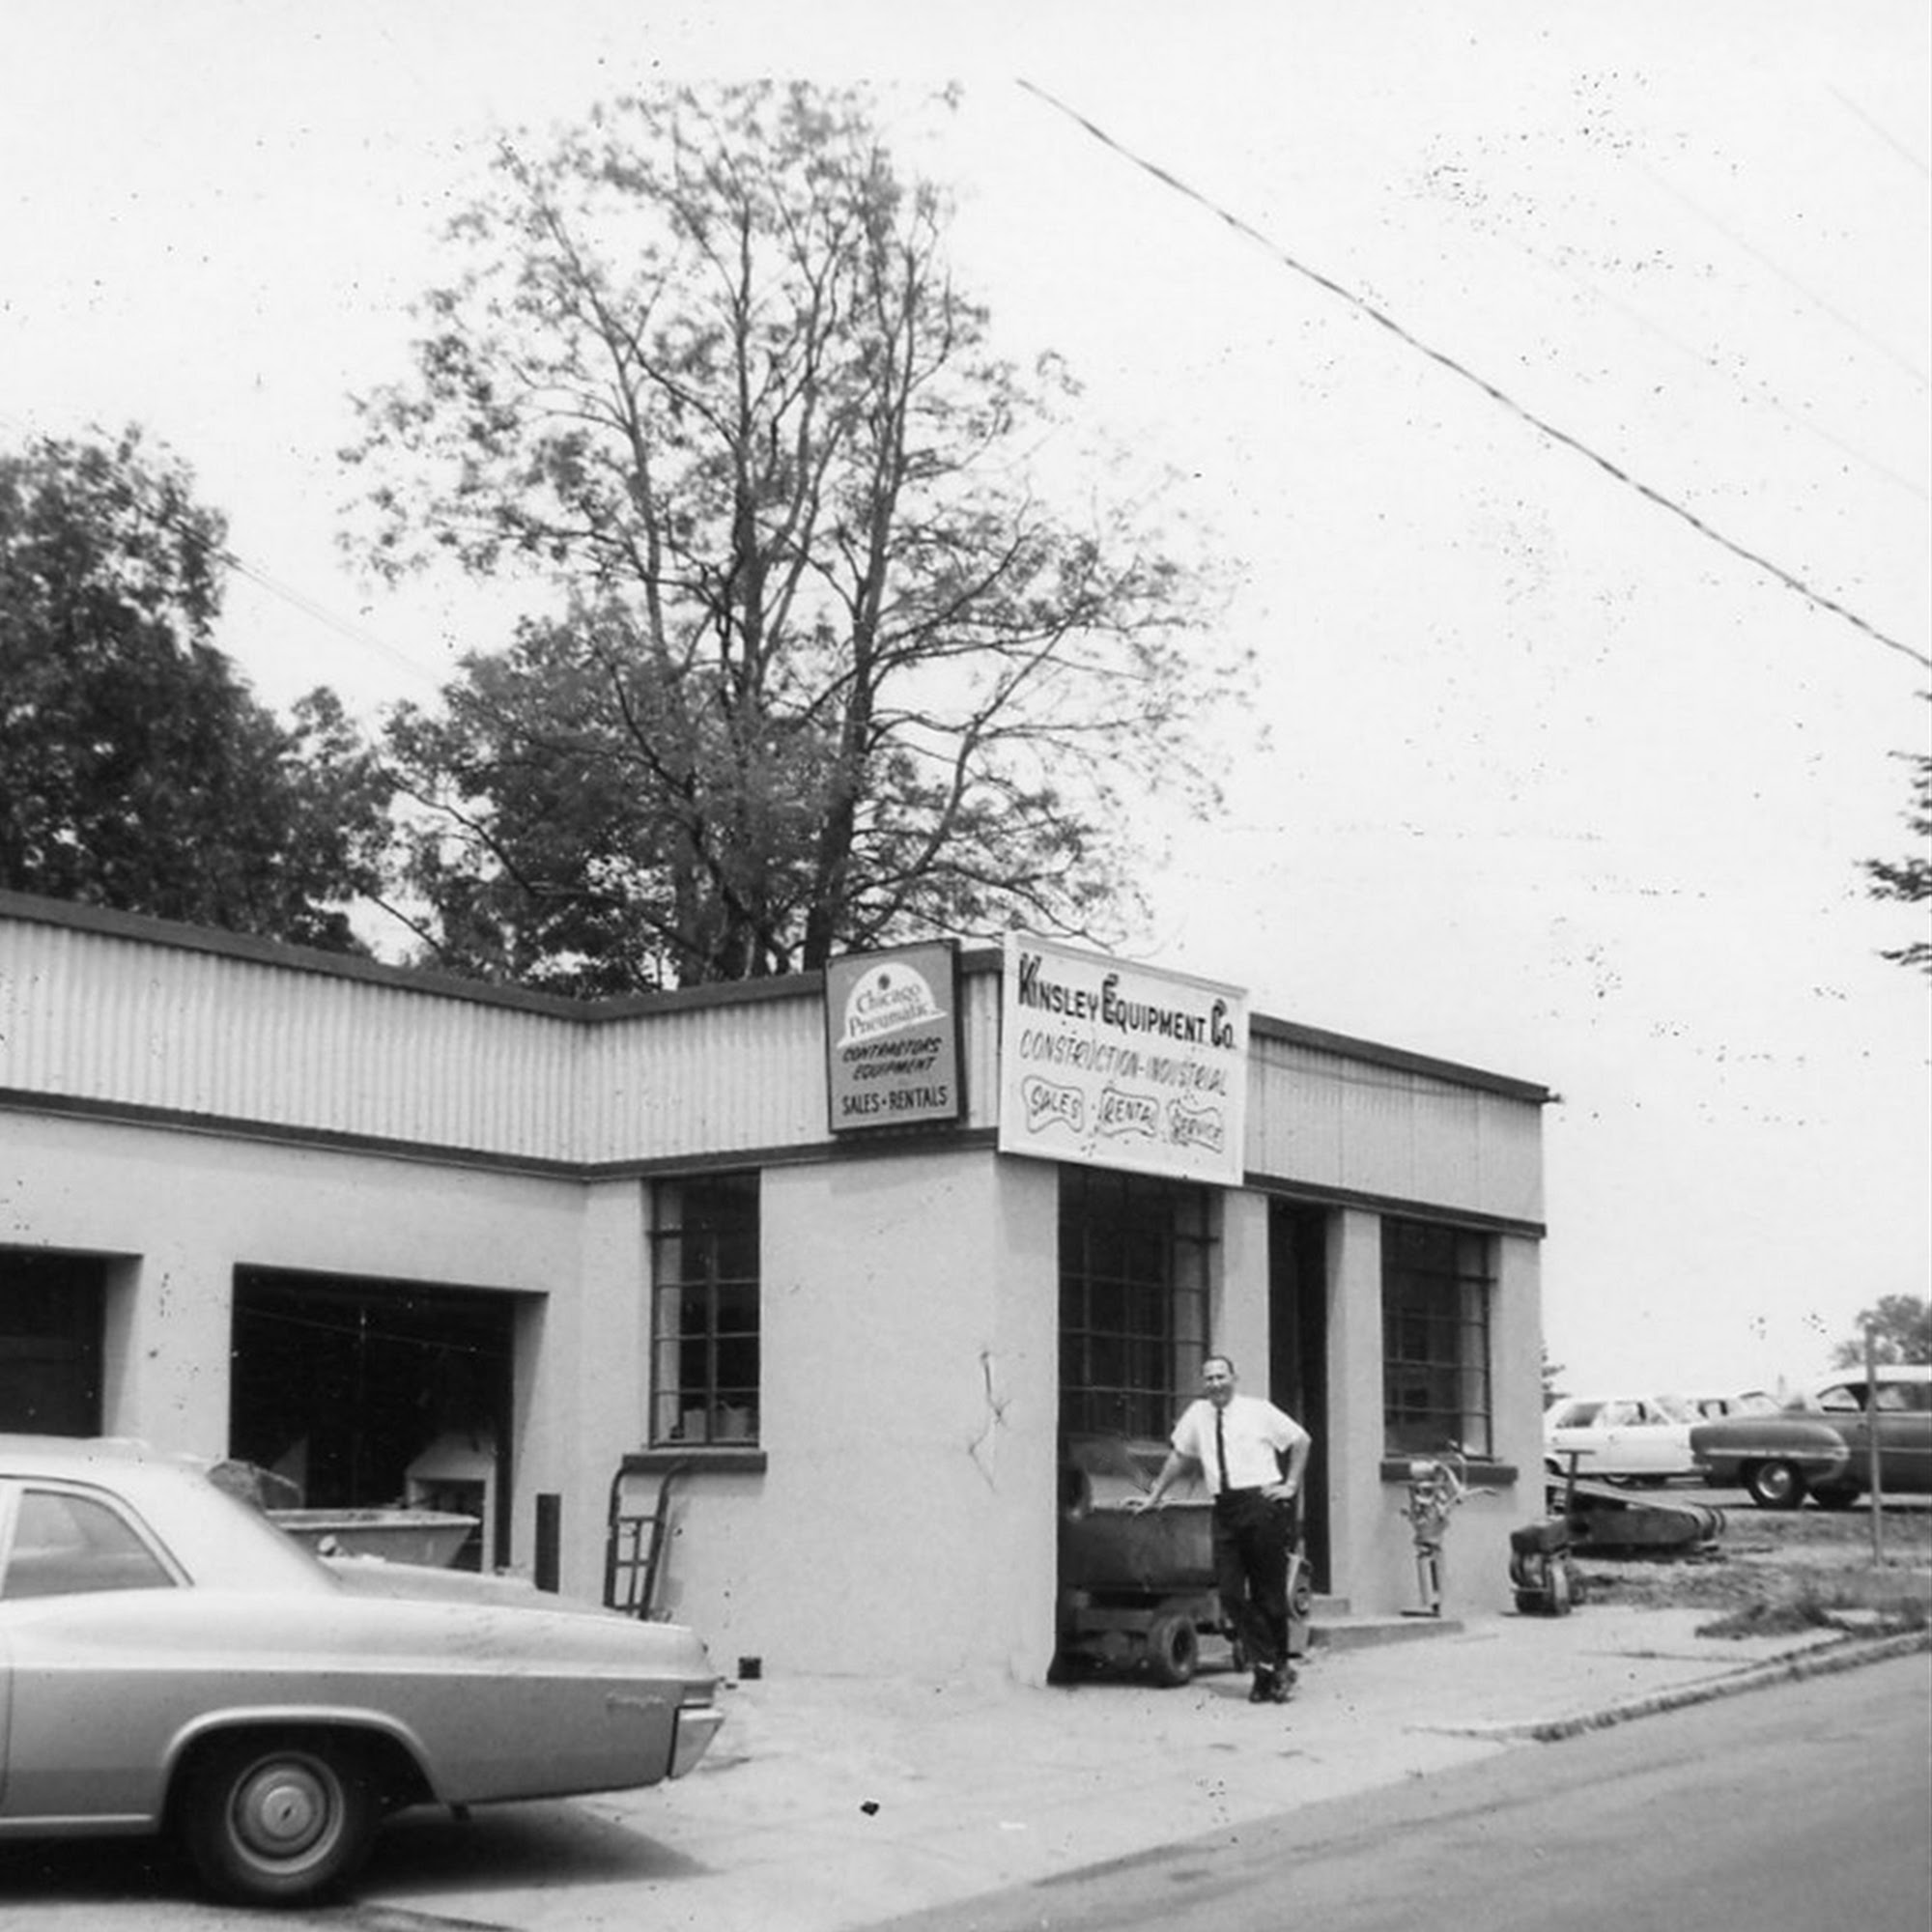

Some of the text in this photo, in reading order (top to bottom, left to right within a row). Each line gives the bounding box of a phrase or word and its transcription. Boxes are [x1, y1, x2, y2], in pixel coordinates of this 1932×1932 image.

[1018, 952, 1099, 1021] KINSLEY
[1101, 972, 1207, 1043] EQUIPMENT
[852, 1056, 937, 1081] EQUIPMENT
[842, 1085, 949, 1116] SALES RENTALS
[1030, 1085, 1081, 1120] SALES
